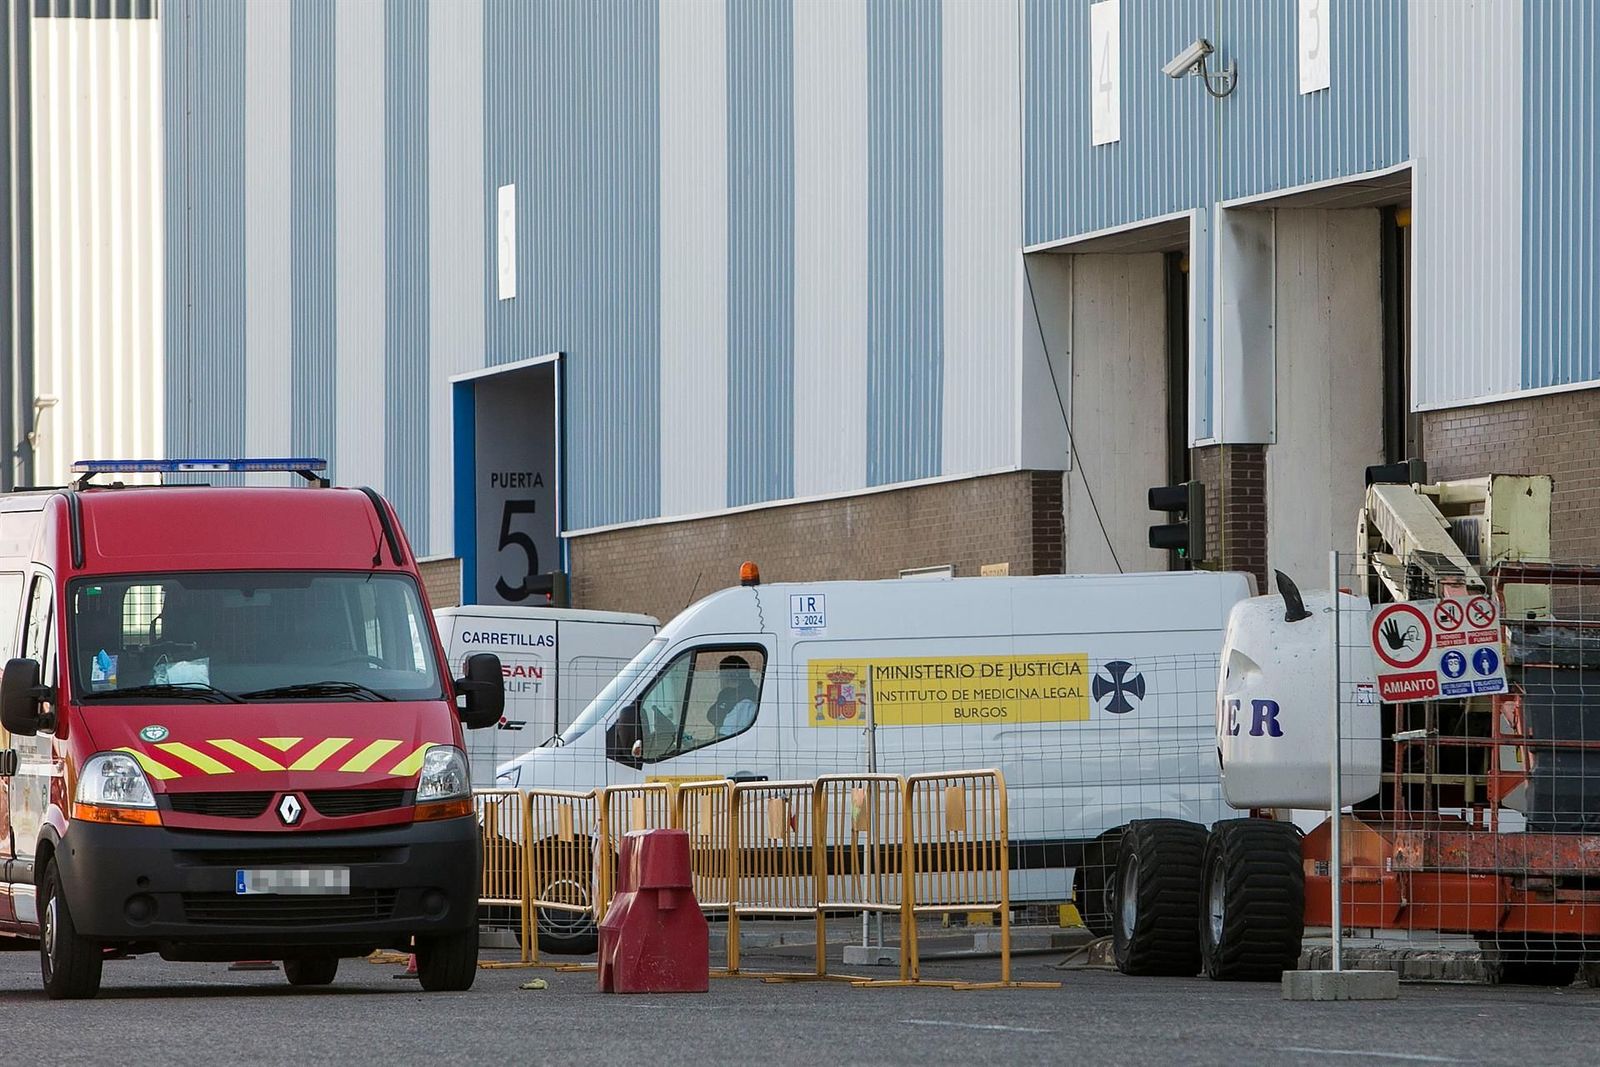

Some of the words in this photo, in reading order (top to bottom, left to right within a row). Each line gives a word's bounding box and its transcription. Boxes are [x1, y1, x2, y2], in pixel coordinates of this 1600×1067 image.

[1099, 30, 1113, 113] 4
[491, 472, 544, 489] PUERTA
[495, 499, 539, 602] 5
[462, 631, 555, 647] CARRETILLAS
[501, 665, 543, 678] SAN
[876, 663, 975, 679] MINISTERIO
[981, 663, 1004, 678] DE
[1008, 661, 1082, 681] JUSTICIA
[504, 681, 542, 693] LIFT
[876, 689, 948, 702] INSTITUTO
[952, 689, 969, 700] DE
[973, 688, 1040, 700] MEDICINA
[1043, 687, 1084, 699] LEGAL
[1383, 678, 1436, 695] AMIANTO
[954, 706, 1008, 718] BURGOS
